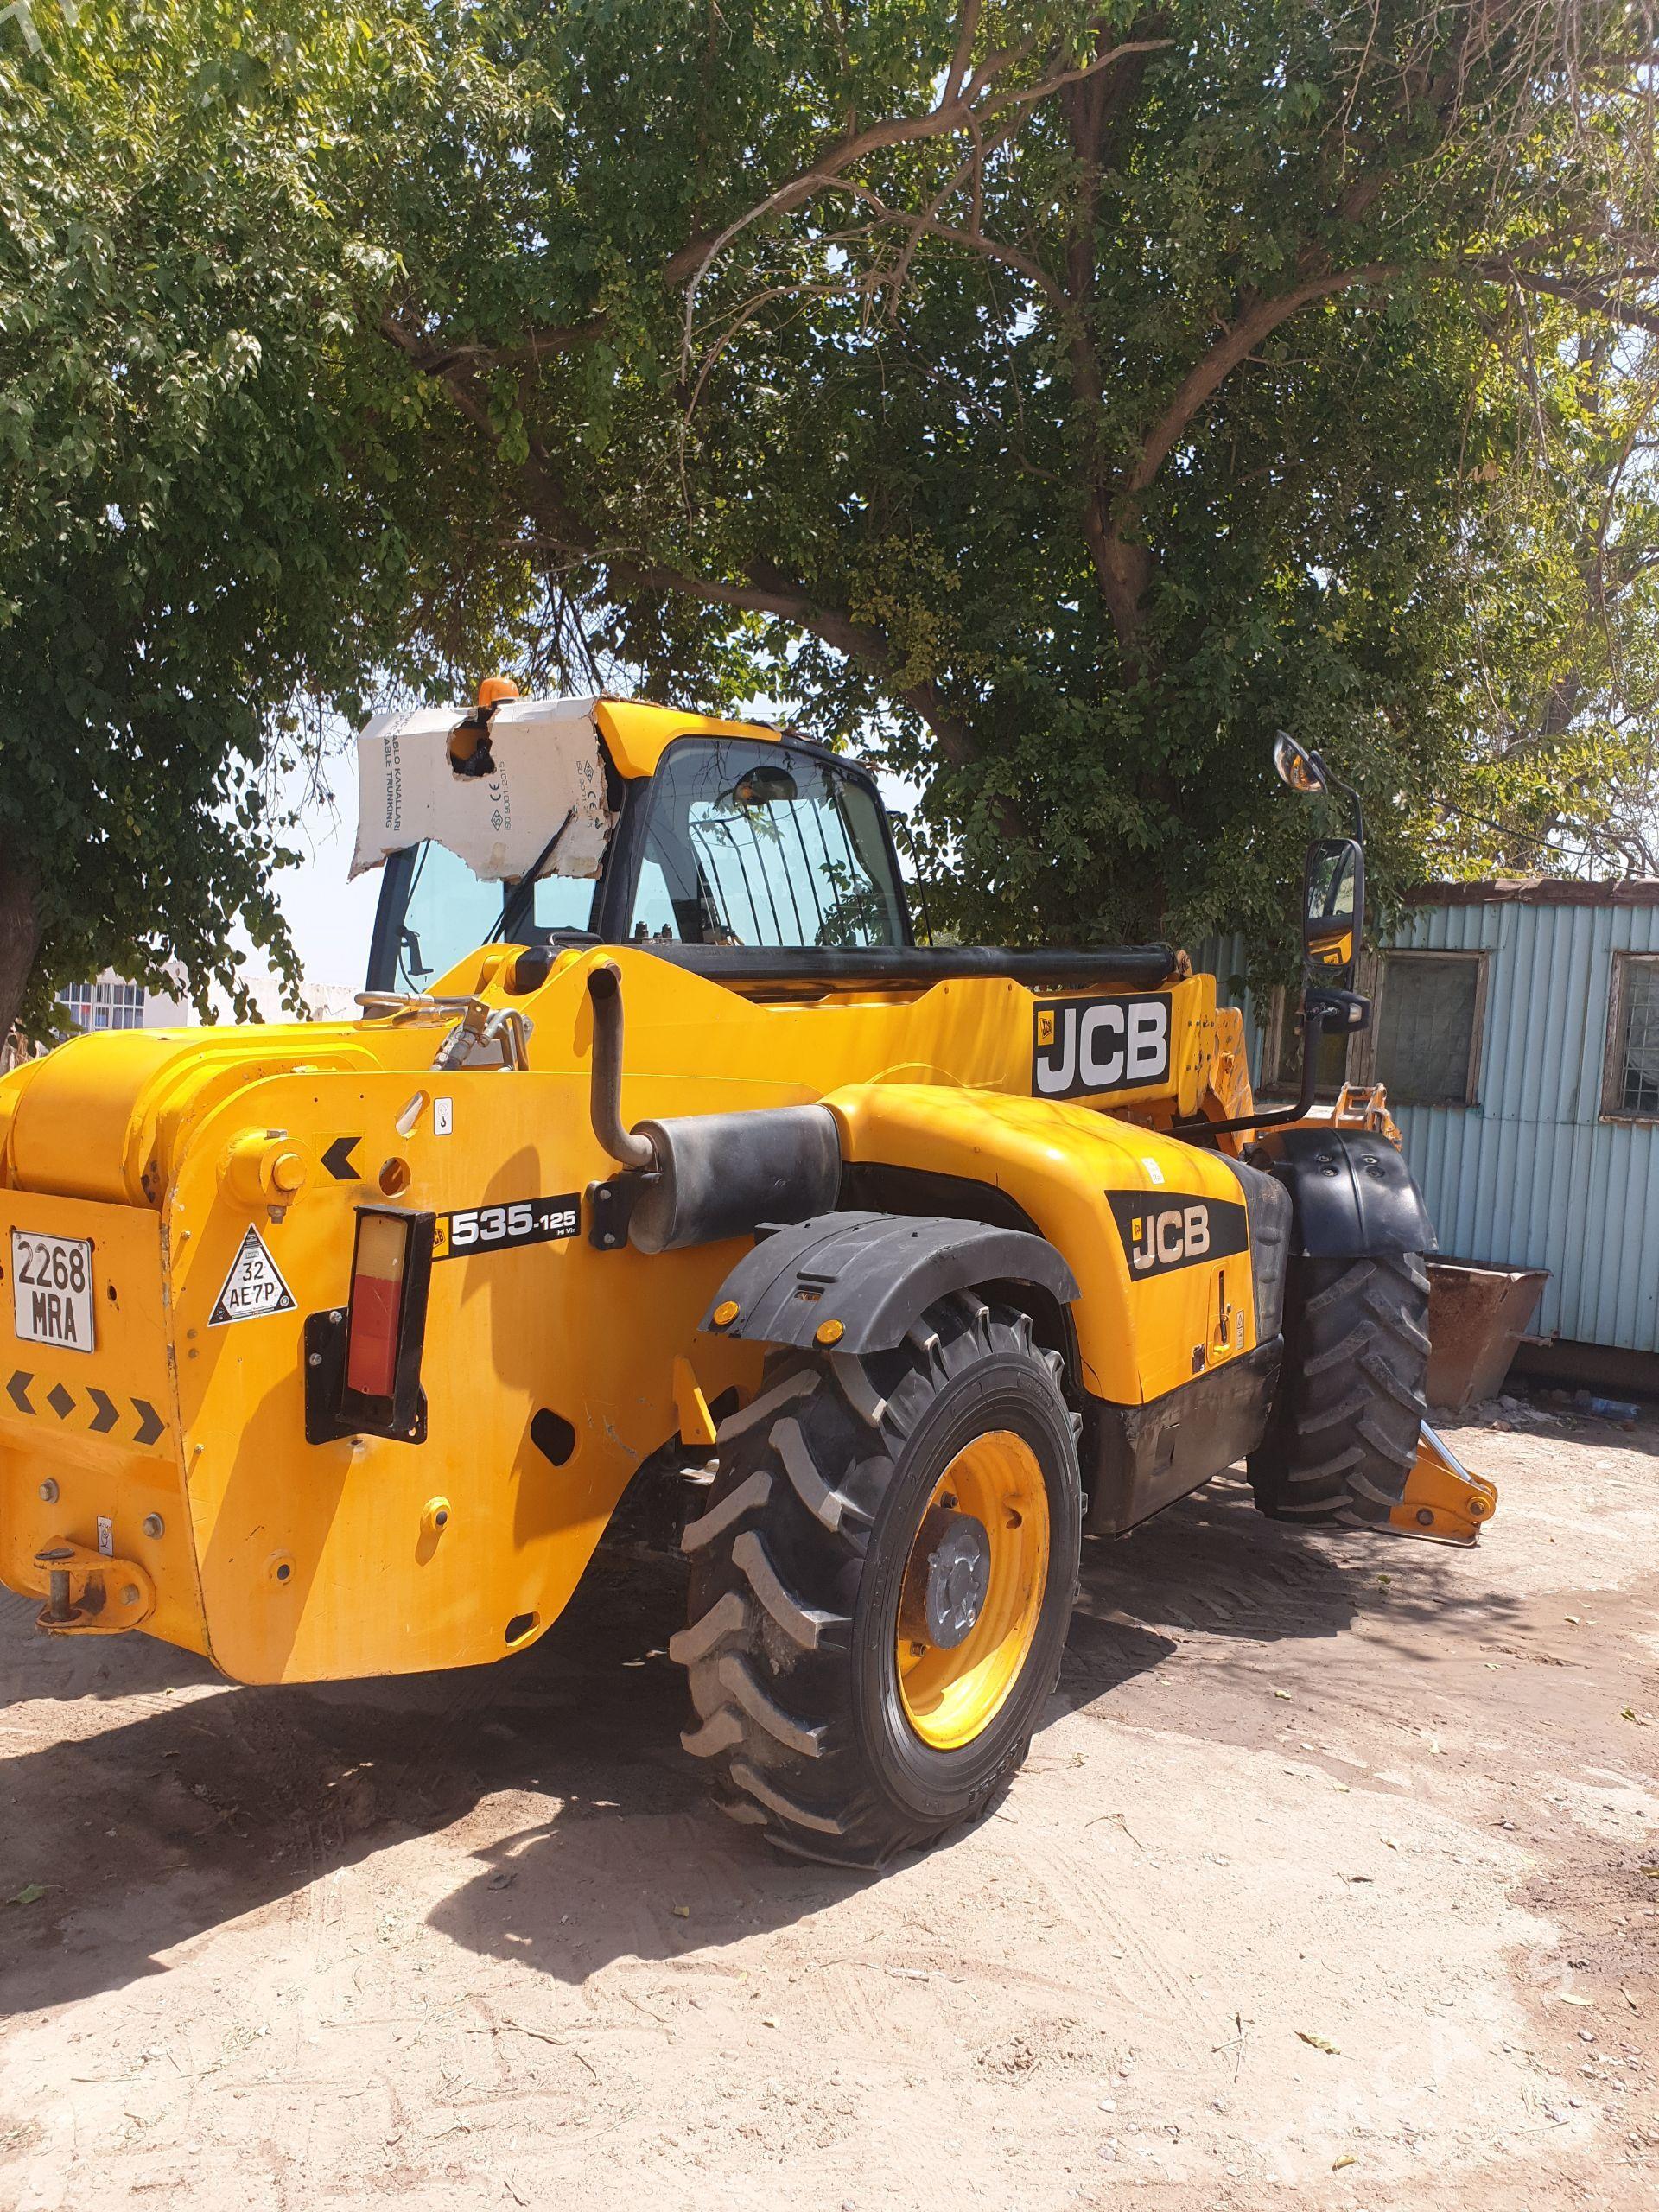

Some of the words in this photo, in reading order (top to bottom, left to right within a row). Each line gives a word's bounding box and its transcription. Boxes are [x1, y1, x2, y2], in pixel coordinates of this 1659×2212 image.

[1037, 1001, 1167, 1093] JCB
[432, 1229, 444, 1246] CB
[452, 1204, 576, 1246] 535-125
[1133, 1205, 1210, 1270] JCB
[17, 1240, 86, 1294] 2268
[242, 1261, 264, 1281] 32
[32, 1291, 77, 1343] MRA
[230, 1282, 275, 1308] AE7P
